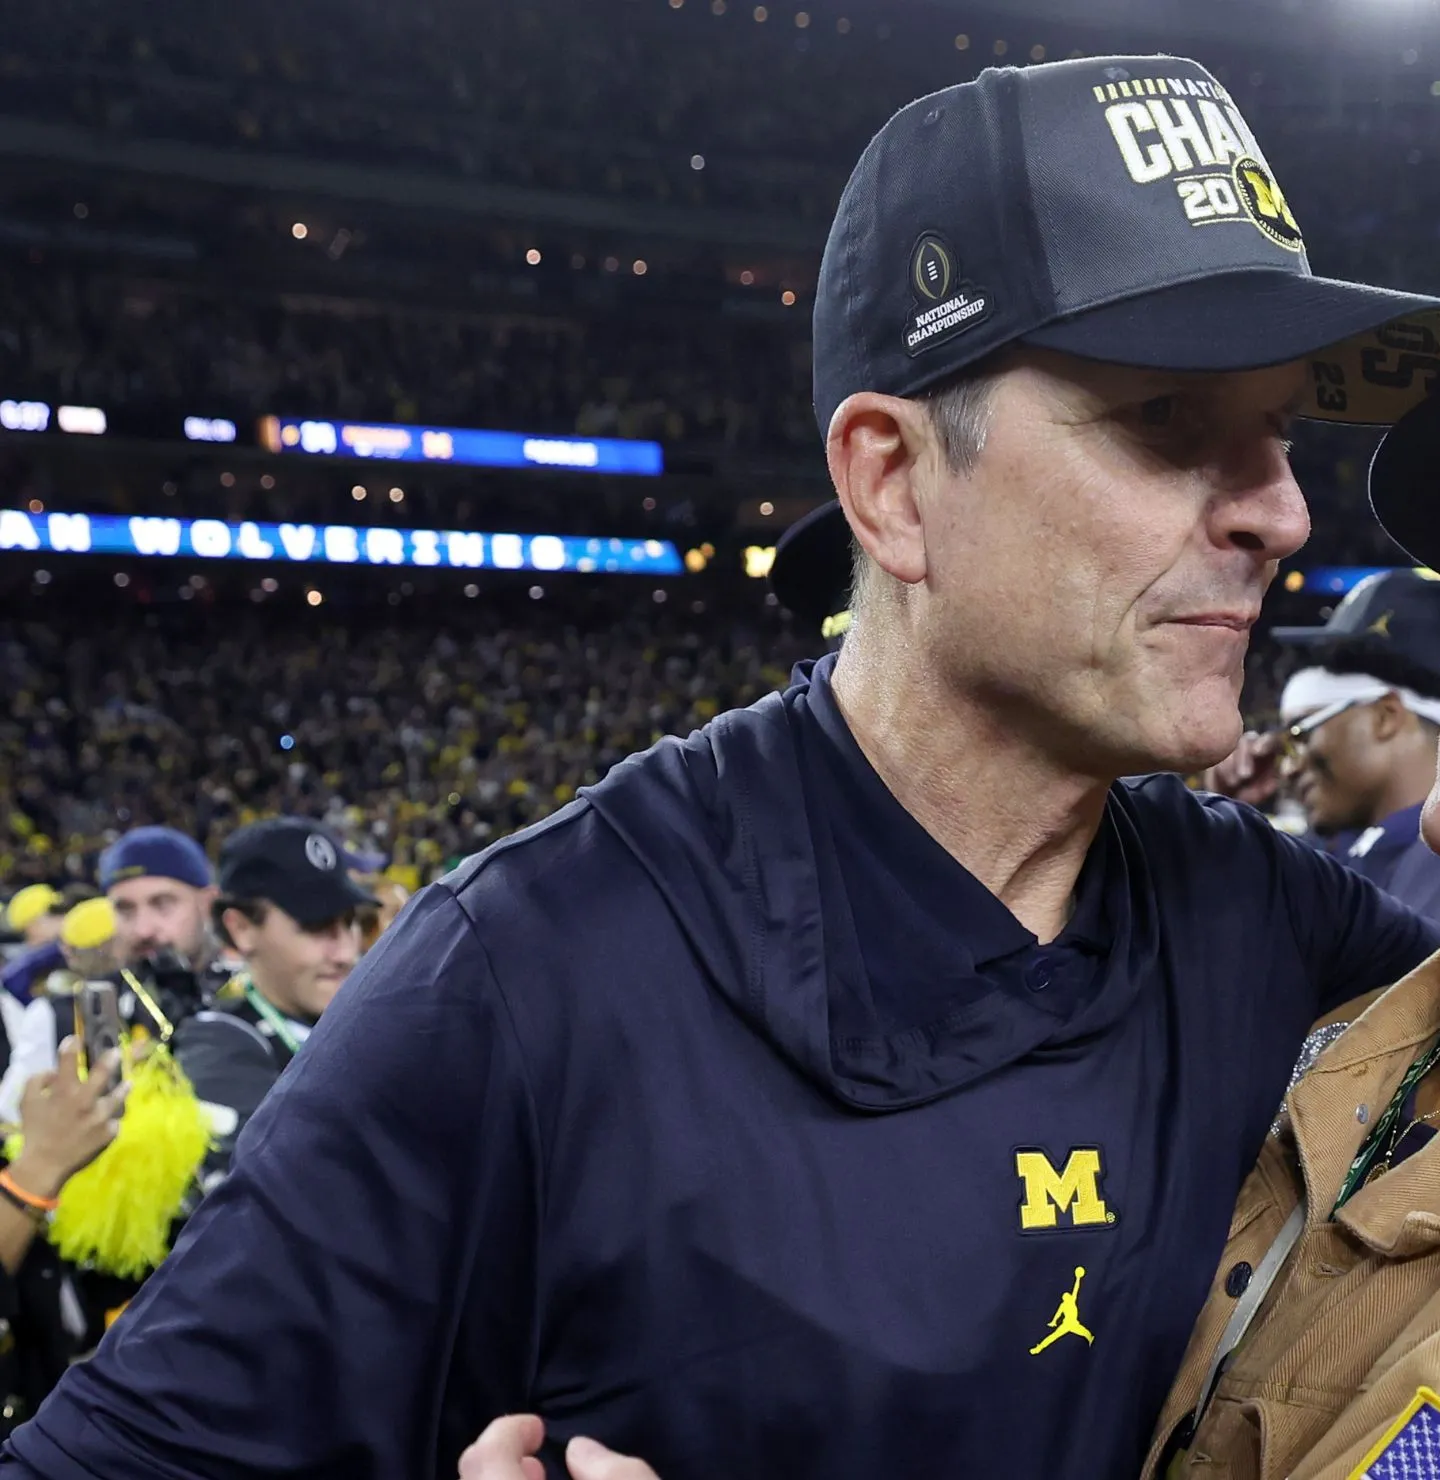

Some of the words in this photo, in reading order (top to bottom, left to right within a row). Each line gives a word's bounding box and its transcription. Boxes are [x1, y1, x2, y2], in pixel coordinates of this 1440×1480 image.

[907, 298, 985, 346] CHAMPIONSHIP
[915, 294, 969, 328] NATIONAL
[129, 516, 565, 571] WOLVERINES
[1016, 1149, 1107, 1229] M
